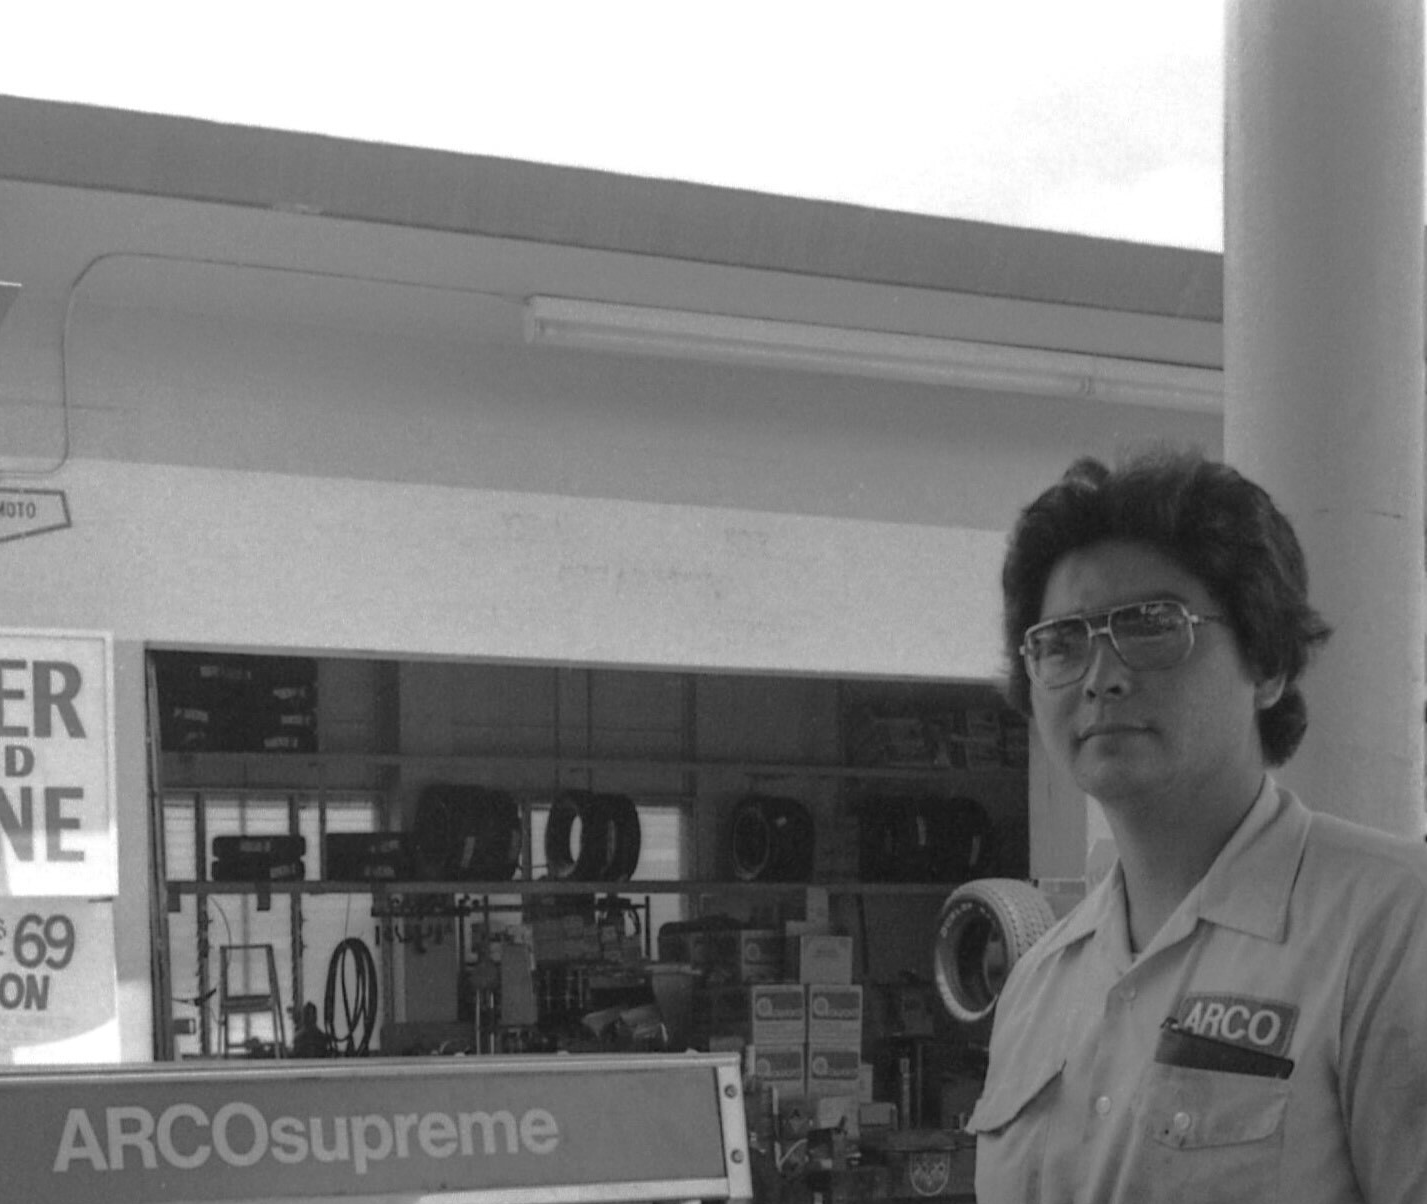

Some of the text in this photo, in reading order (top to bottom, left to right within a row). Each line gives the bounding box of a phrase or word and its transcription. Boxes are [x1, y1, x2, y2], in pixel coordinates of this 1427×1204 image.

[13, 913, 76, 970] 69
[1182, 1001, 1282, 1046] ARCO
[52, 1101, 560, 1175] ARCOsupreme
